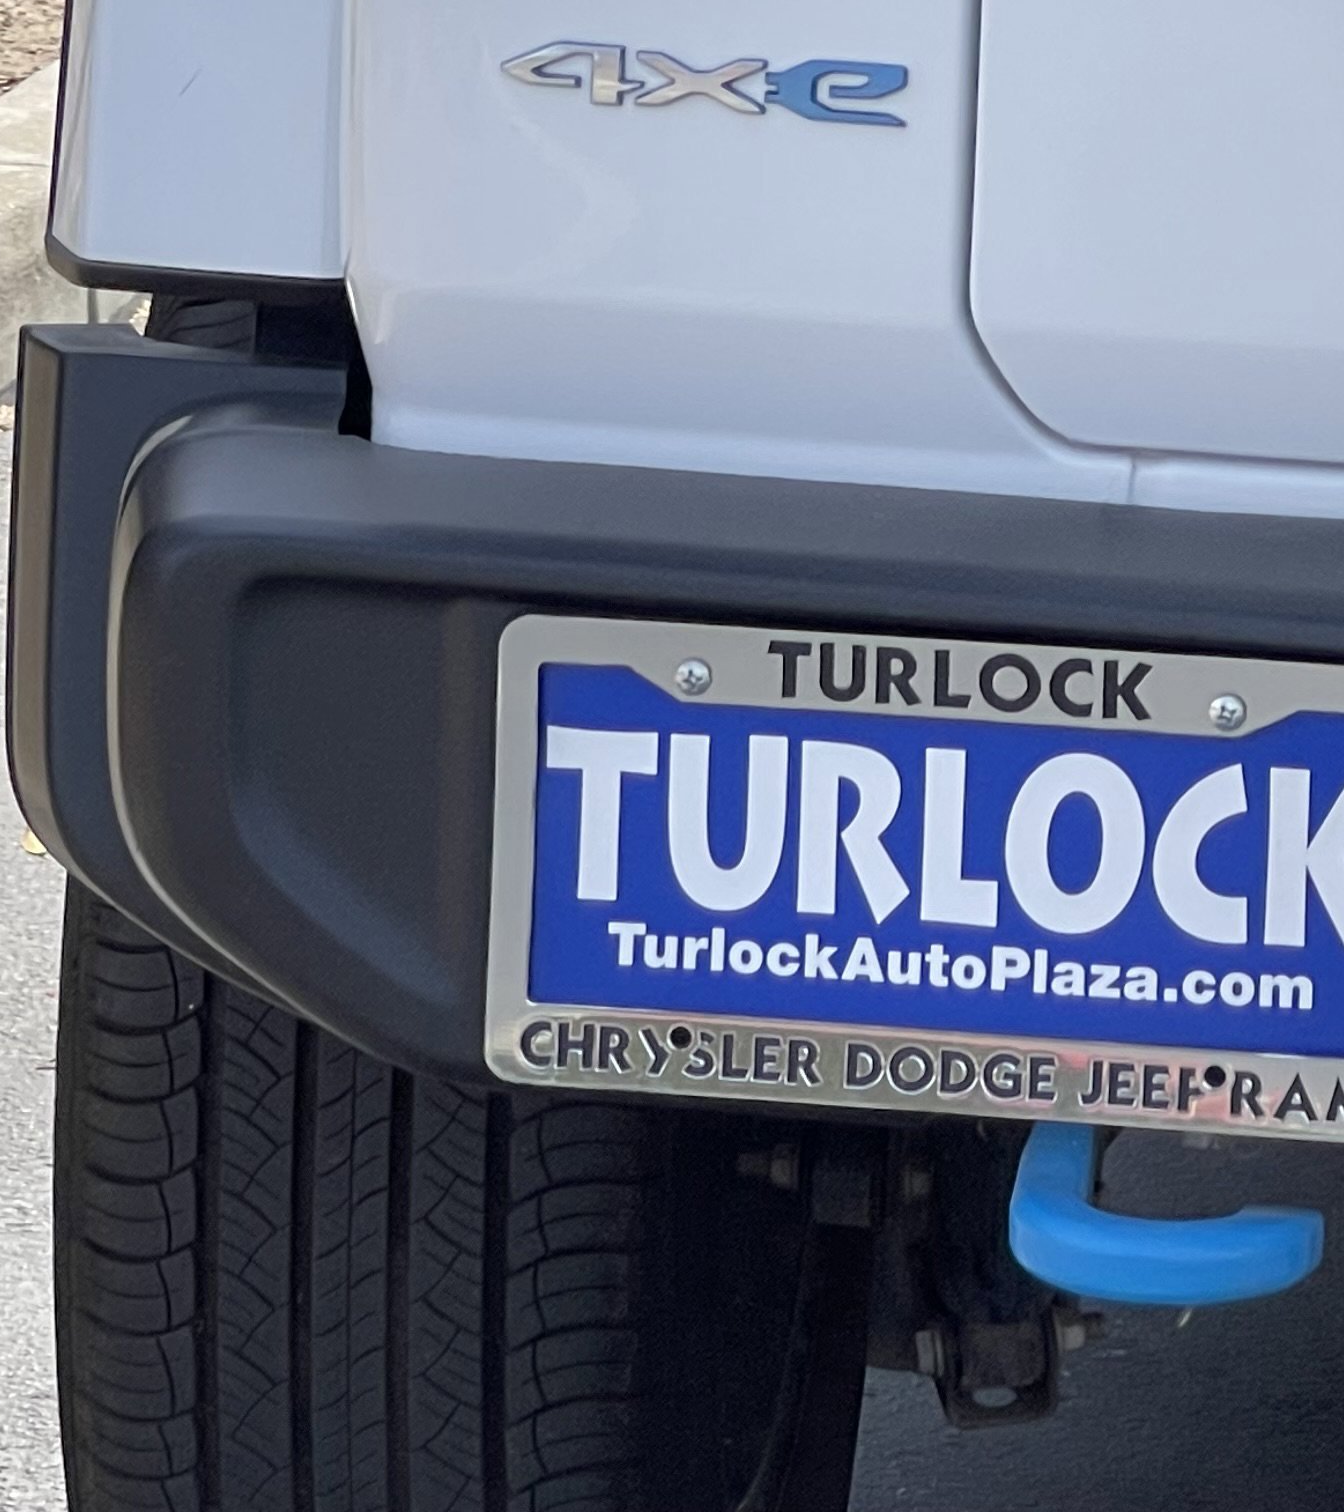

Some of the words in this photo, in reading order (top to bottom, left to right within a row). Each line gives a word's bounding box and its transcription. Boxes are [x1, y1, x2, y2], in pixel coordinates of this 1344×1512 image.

[767, 639, 1153, 721] TURLOCK
[607, 921, 1315, 1010] TurlockAutoPlaza.com
[519, 1020, 822, 1088] CHRYSLER
[845, 1042, 1058, 1104] DODGE
